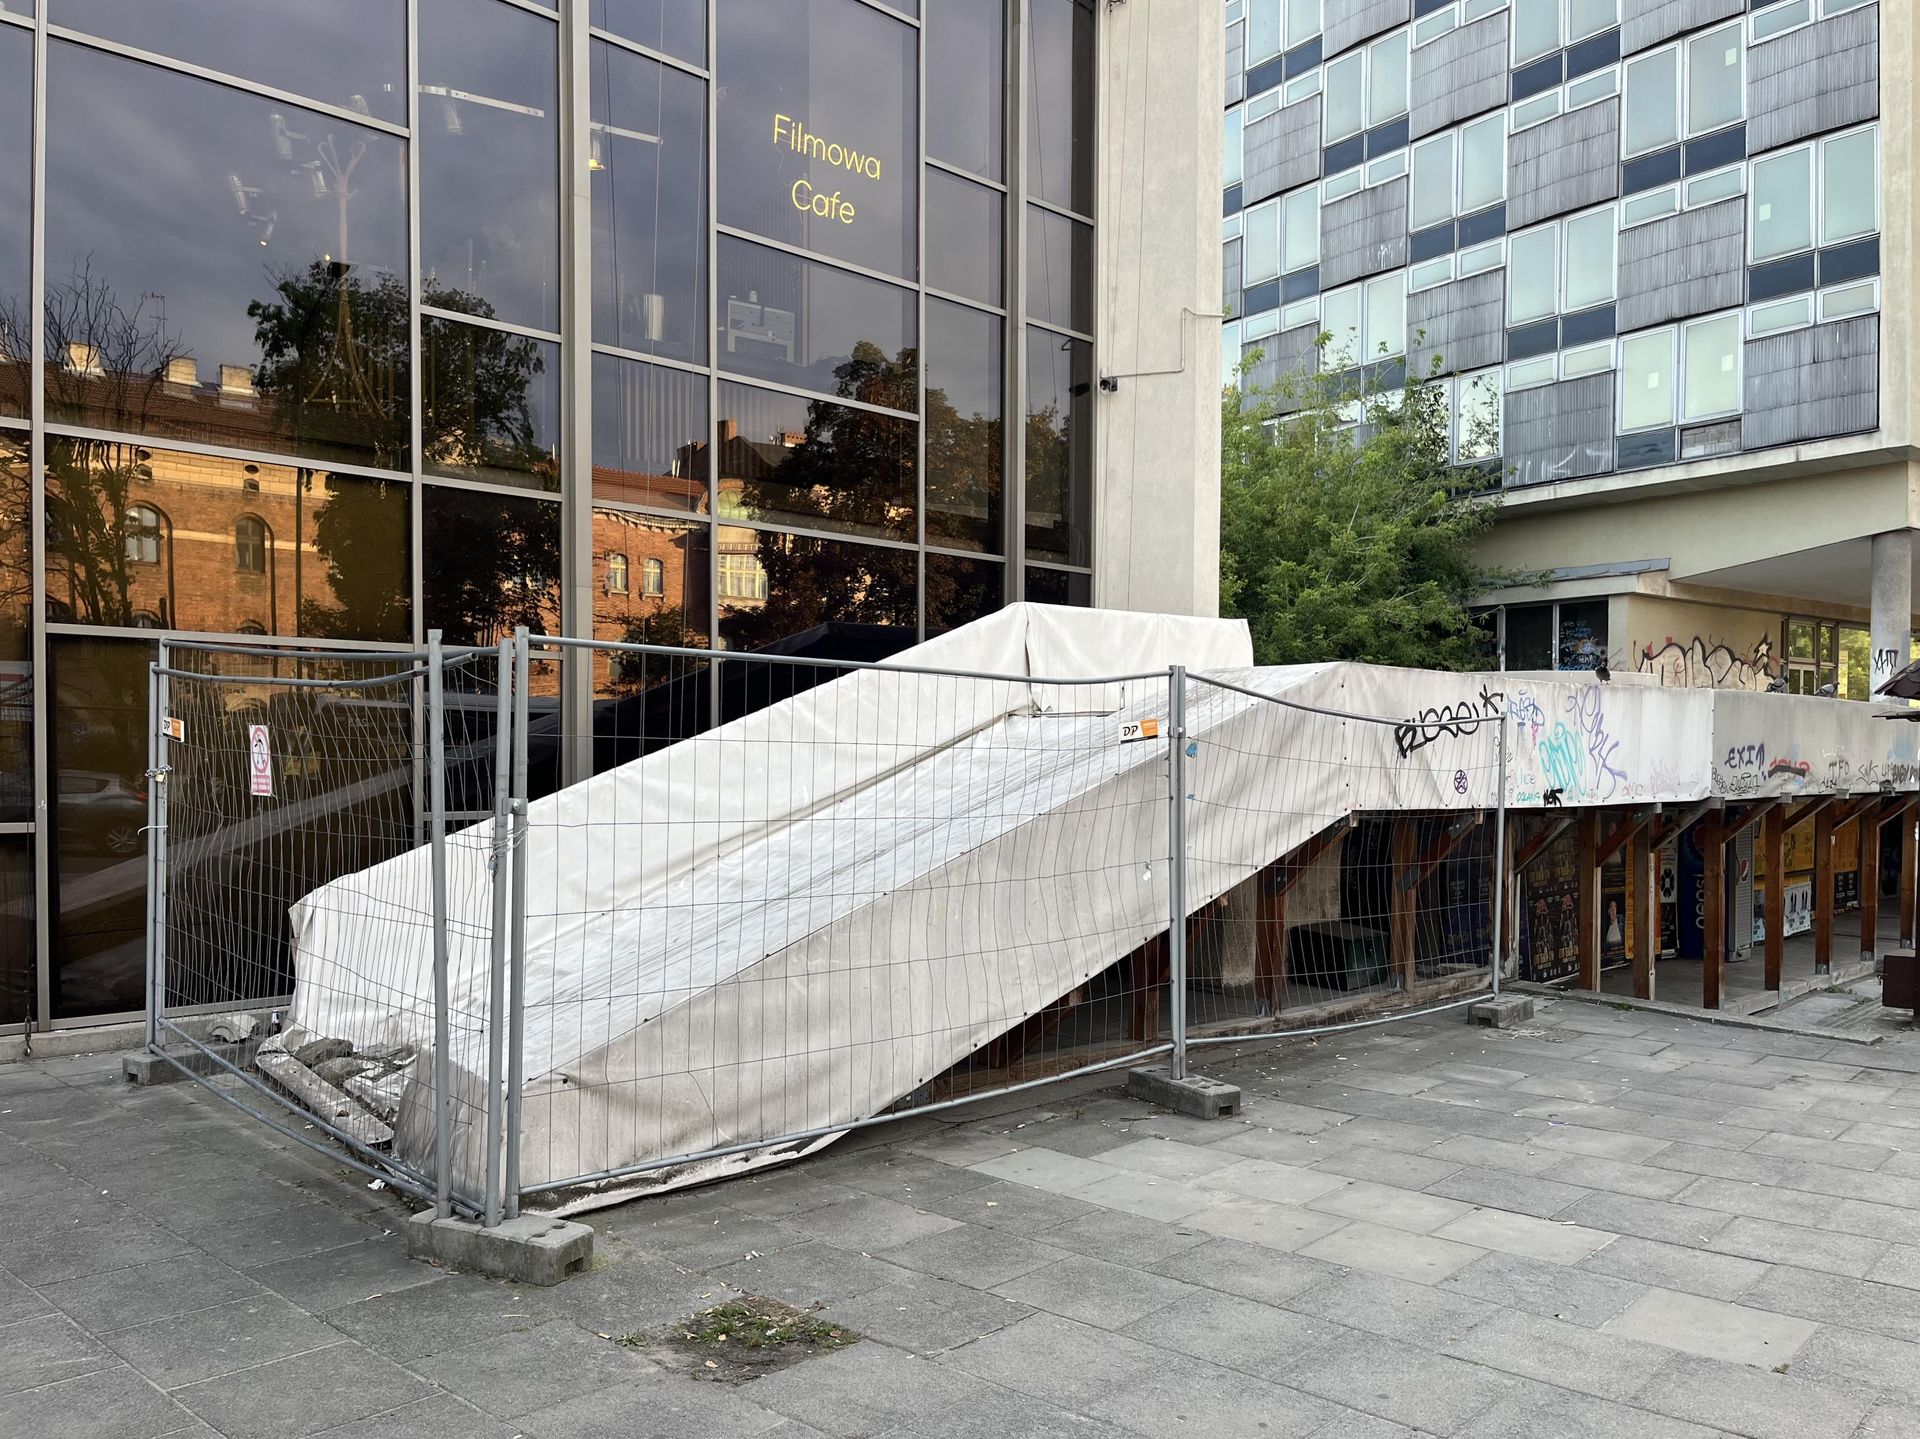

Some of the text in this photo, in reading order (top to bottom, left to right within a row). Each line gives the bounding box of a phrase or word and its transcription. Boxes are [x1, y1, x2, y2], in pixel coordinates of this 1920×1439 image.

[773, 113, 881, 180] Filmowa
[791, 179, 855, 224] Cafe
[1122, 725, 1139, 737] DP
